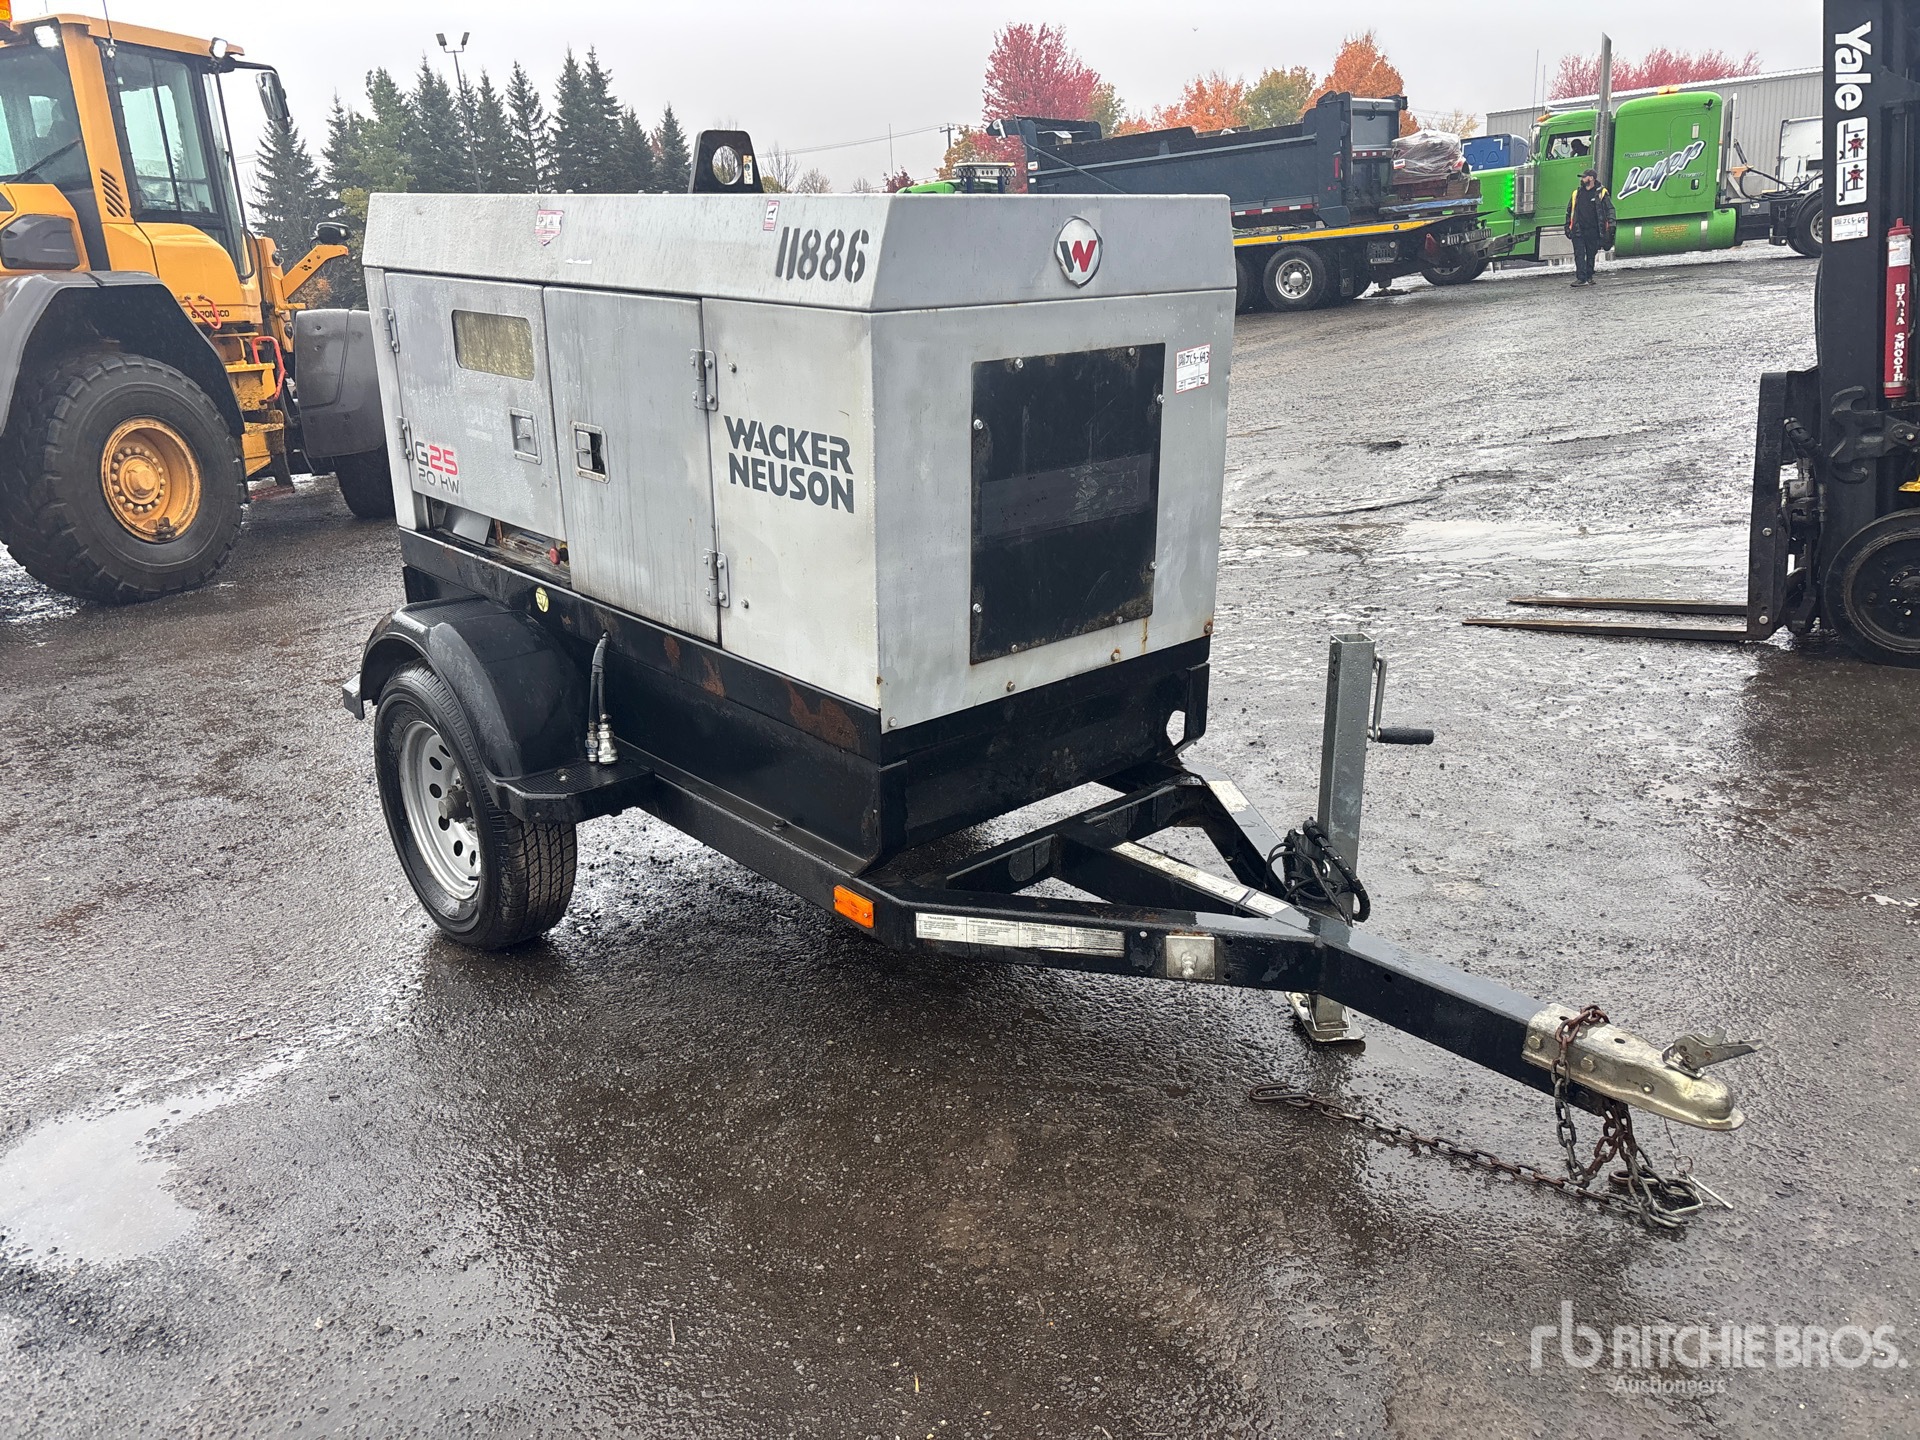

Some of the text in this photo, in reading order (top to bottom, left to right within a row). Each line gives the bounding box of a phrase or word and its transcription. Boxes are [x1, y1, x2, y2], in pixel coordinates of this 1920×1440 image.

[1834, 20, 1872, 111] Yale
[775, 226, 870, 283] 11886
[1059, 240, 1097, 273] W
[1893, 332, 1905, 382] SMOOTH
[415, 441, 458, 475] G25
[723, 415, 854, 475] WACKER
[728, 452, 855, 514] NEUSON
